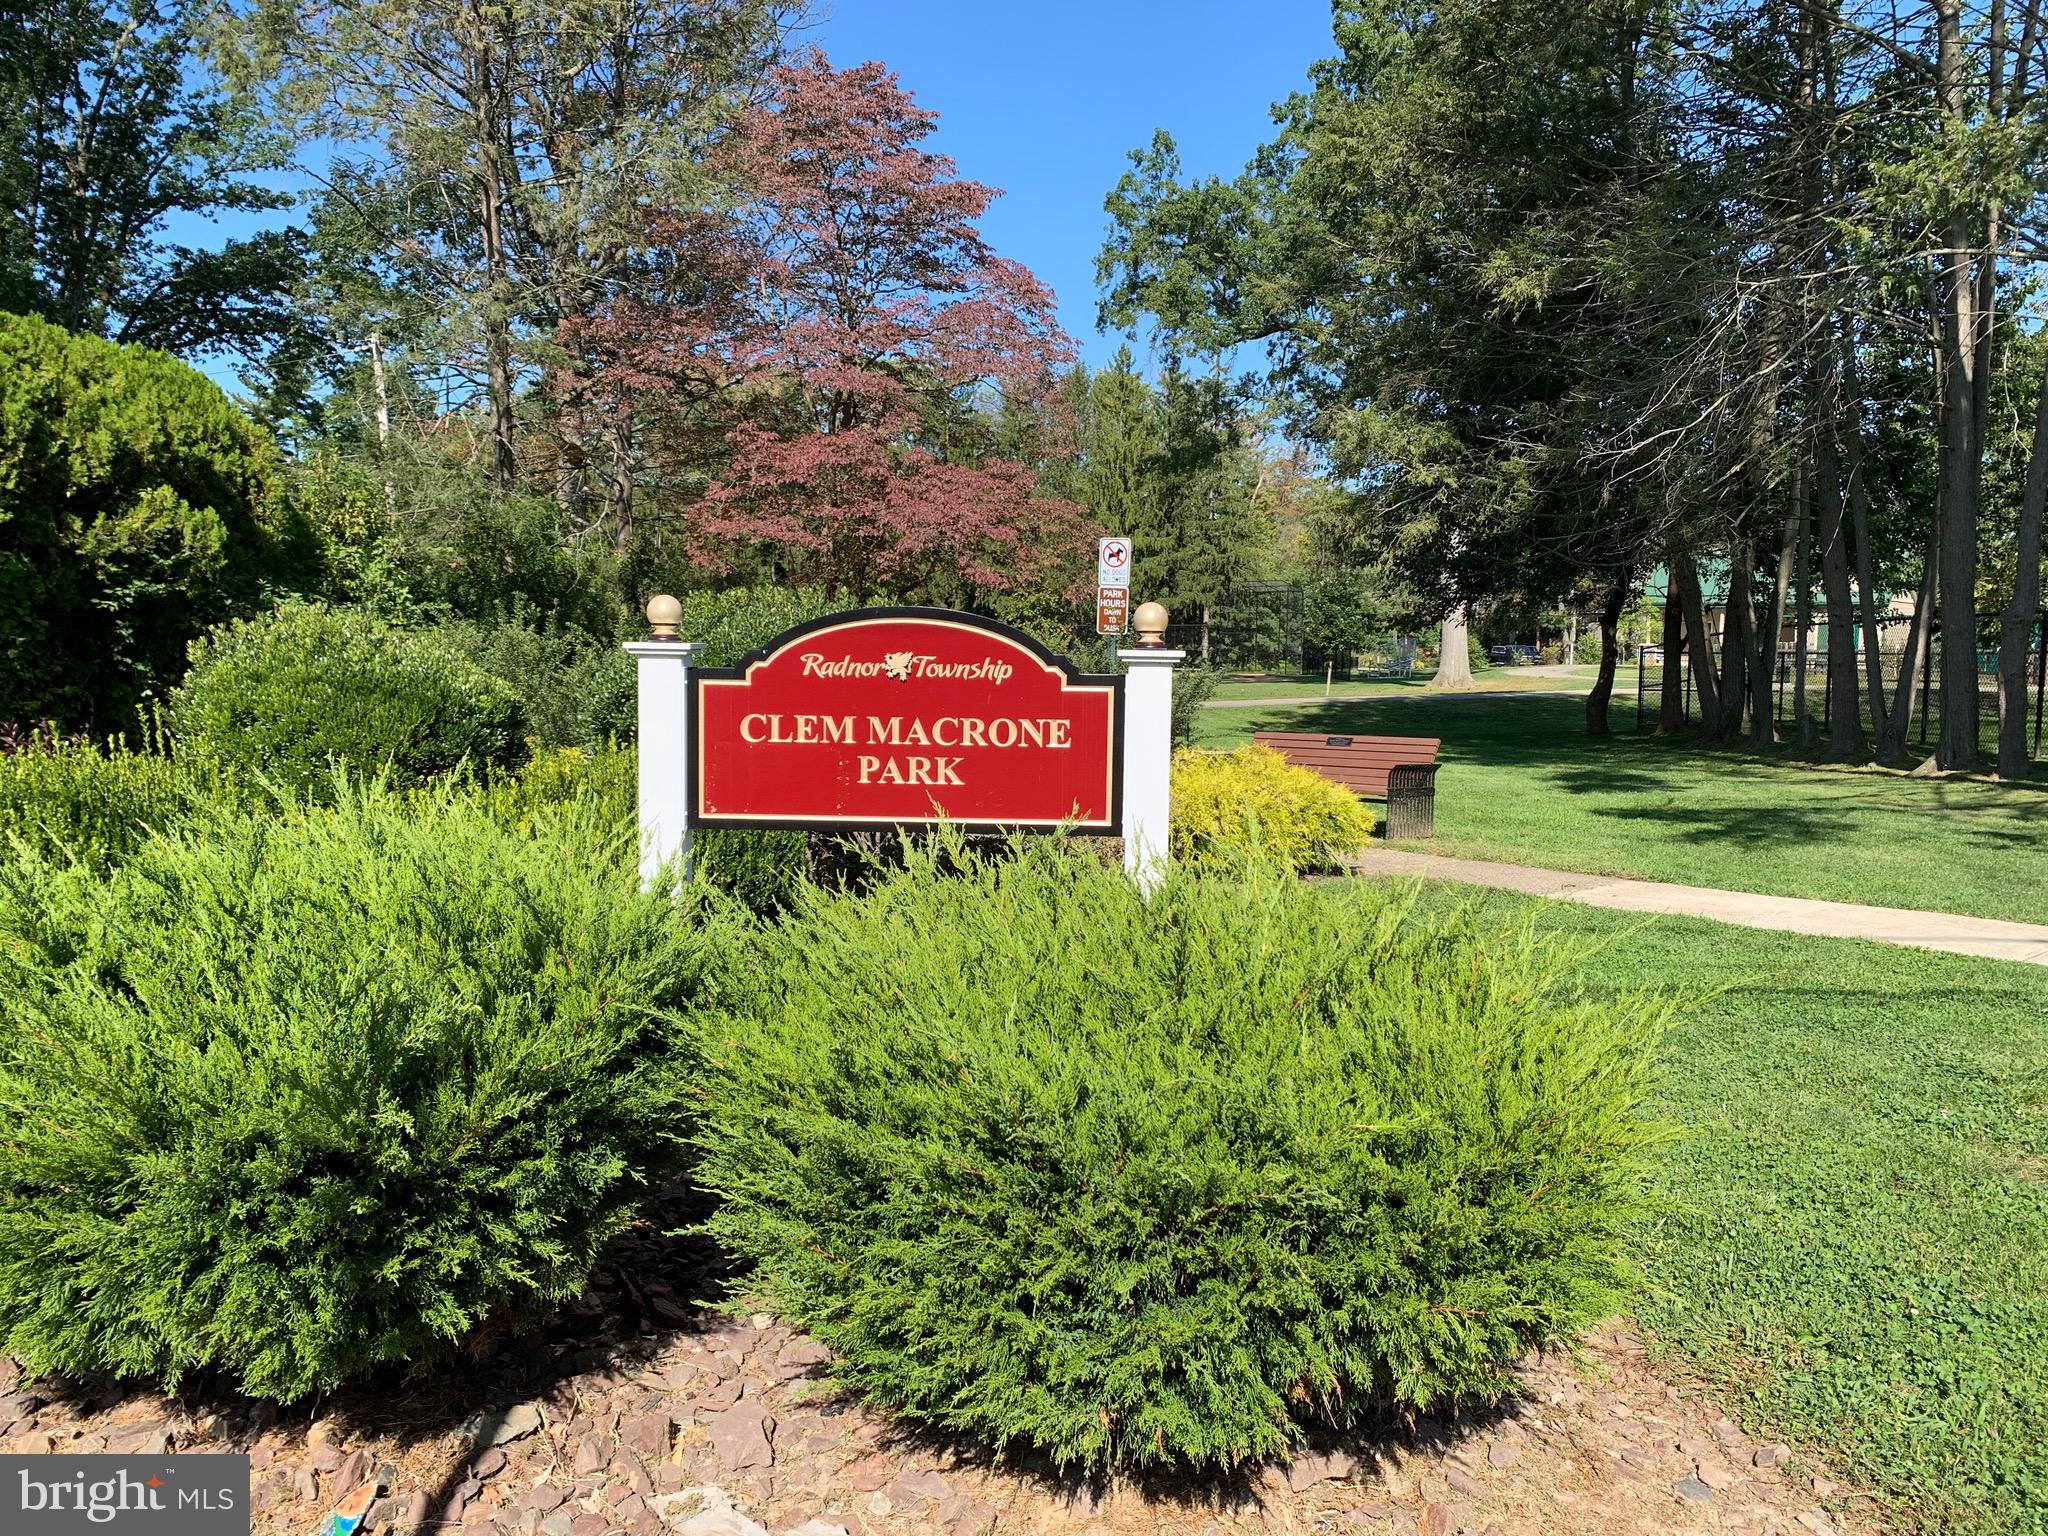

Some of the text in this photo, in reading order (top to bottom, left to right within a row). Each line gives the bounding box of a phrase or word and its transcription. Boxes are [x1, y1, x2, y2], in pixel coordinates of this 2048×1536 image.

[1100, 599, 1126, 608] HOURS
[1103, 590, 1123, 598] PARK
[799, 653, 1013, 685] Radnor Township
[739, 714, 1072, 749] CLEM MACRONE
[857, 755, 966, 787] PARK
